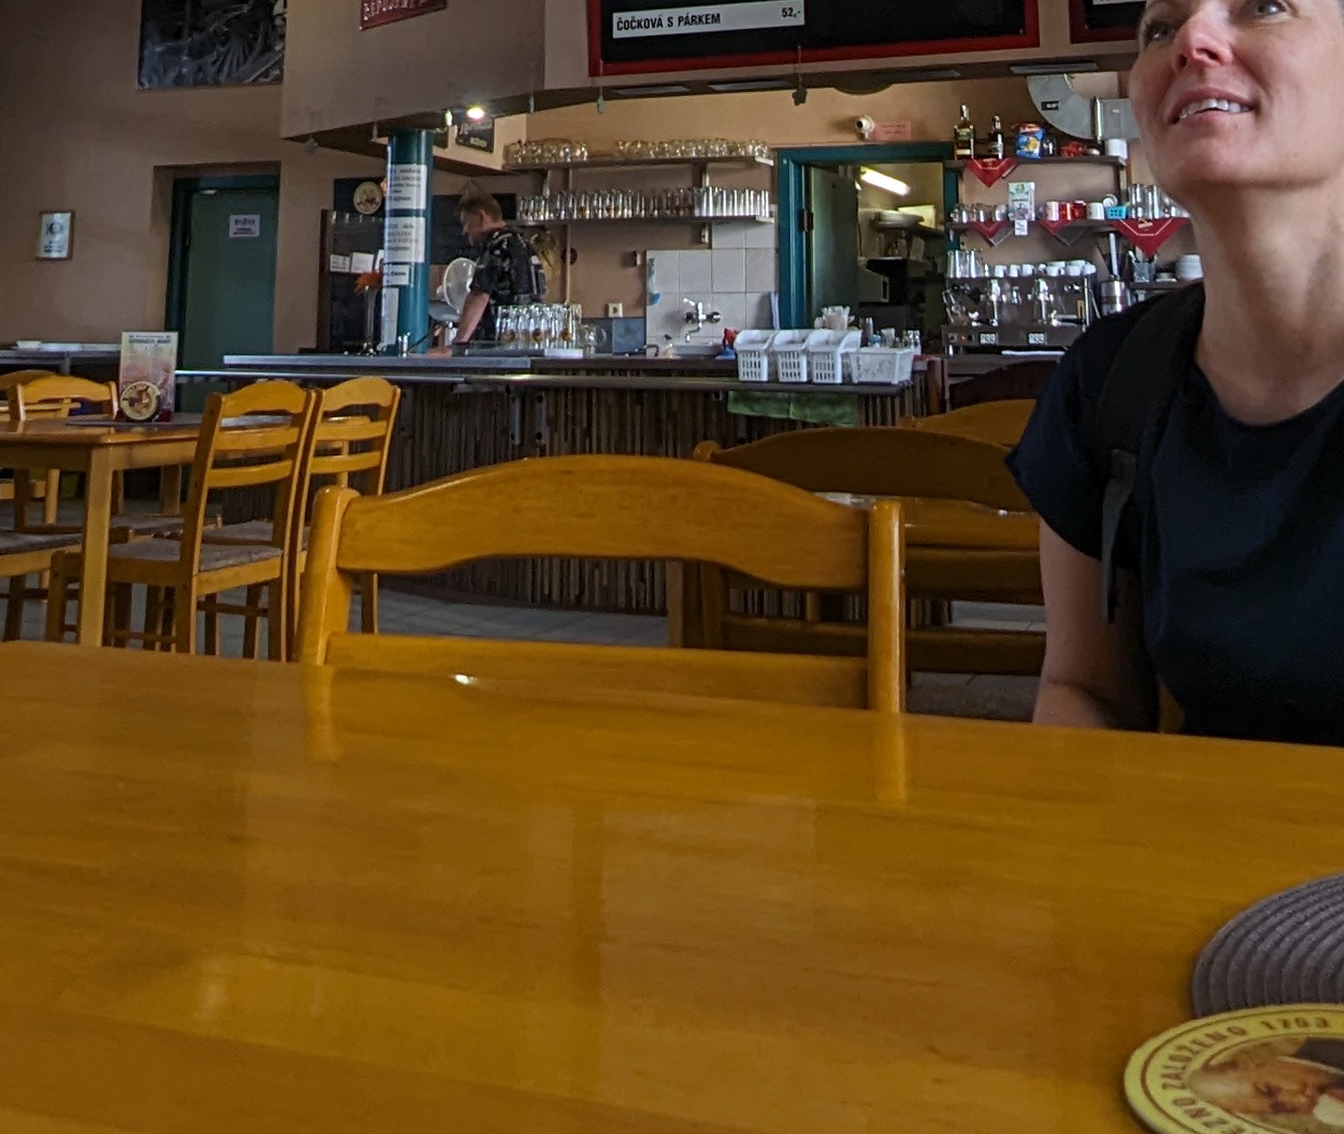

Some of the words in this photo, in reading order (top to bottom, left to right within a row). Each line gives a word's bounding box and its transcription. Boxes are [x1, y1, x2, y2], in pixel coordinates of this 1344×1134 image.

[616, 14, 664, 32] ČOČKOVÁ
[667, 16, 673, 27] S
[677, 12, 722, 27] PÁRKEM
[781, 6, 800, 19] 52,-
